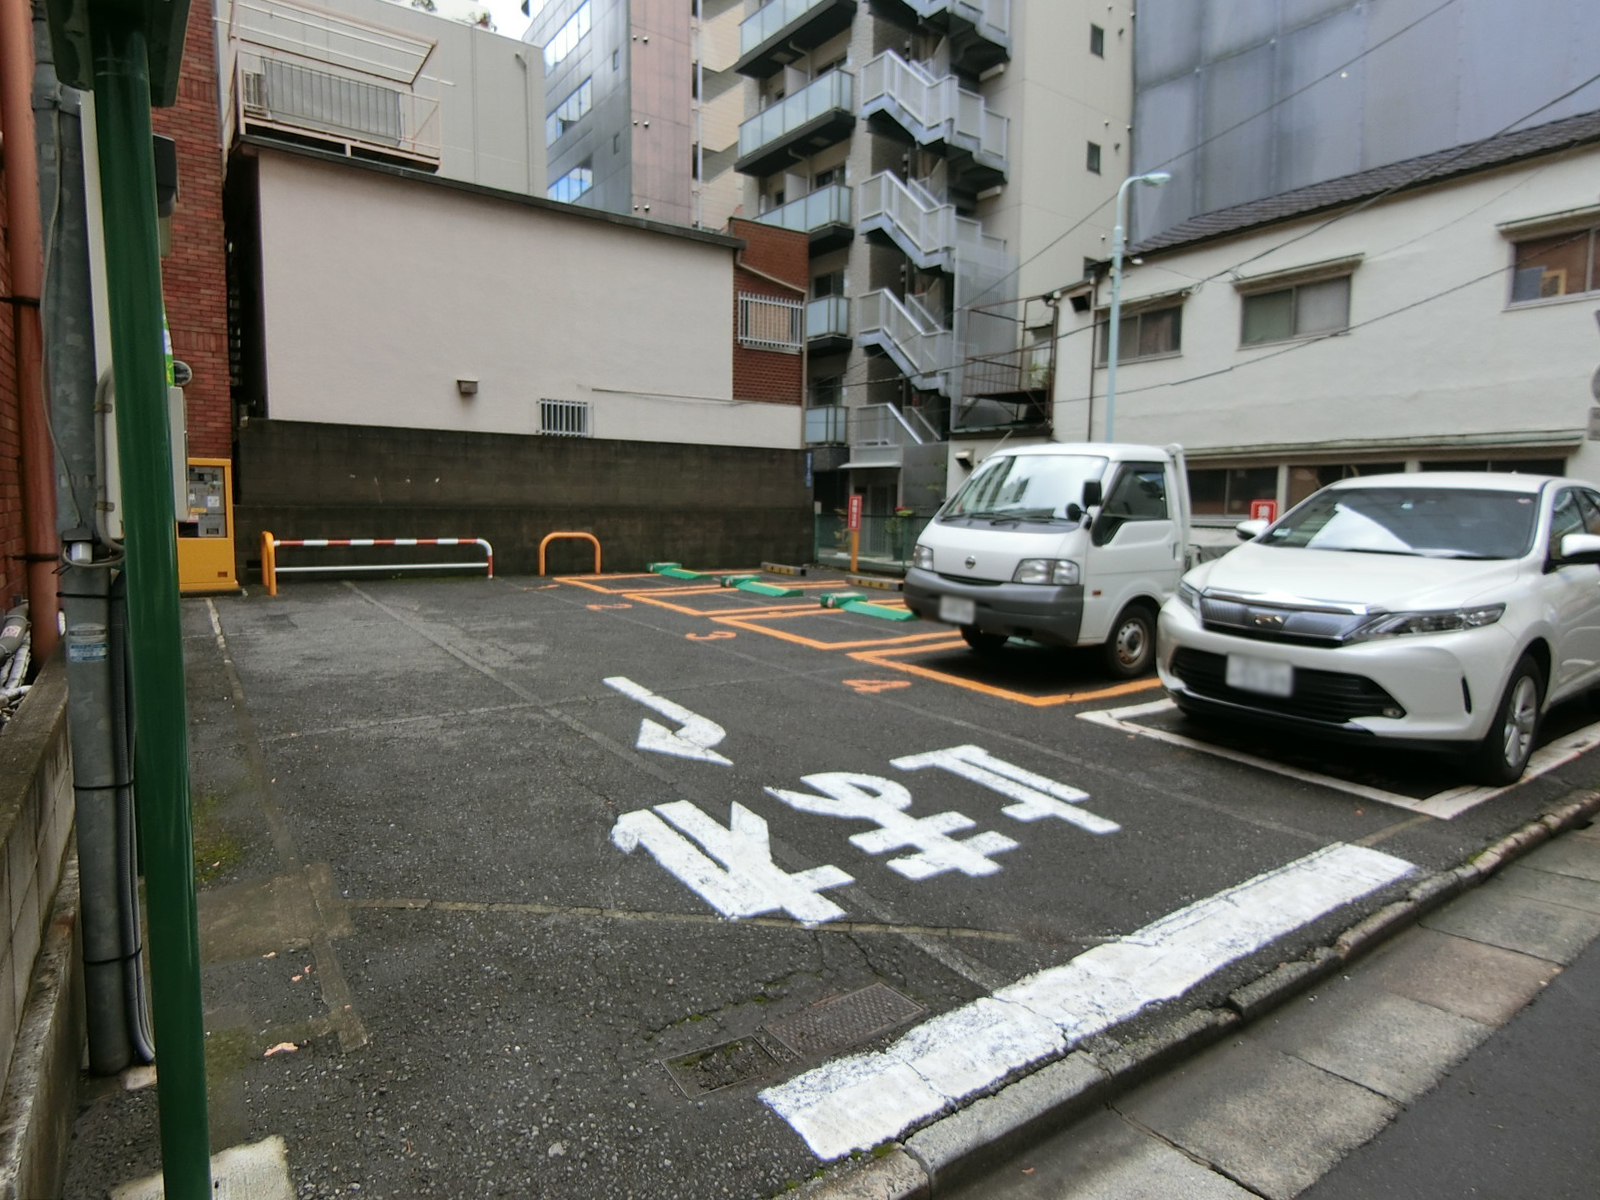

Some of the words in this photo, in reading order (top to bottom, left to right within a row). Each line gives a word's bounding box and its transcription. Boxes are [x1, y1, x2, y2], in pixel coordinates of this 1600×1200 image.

[585, 603, 633, 611] 2
[685, 630, 737, 640] 3
[842, 678, 912, 693] 4
[610, 744, 1121, 928] 止まれ
